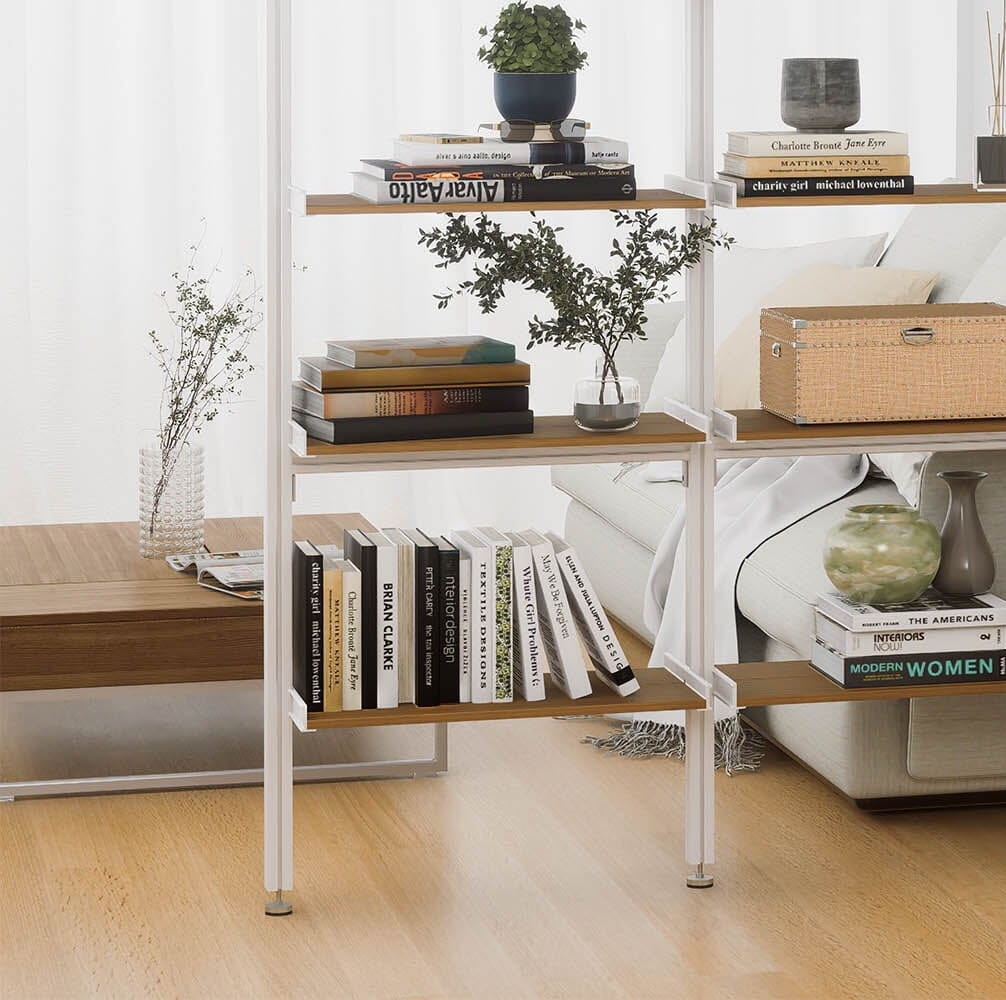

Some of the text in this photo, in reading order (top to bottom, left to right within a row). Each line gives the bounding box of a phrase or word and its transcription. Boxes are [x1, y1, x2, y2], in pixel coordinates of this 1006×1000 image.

[772, 142, 810, 151] Charlotte
[844, 138, 866, 149] Jane
[867, 138, 886, 148] Eyre
[752, 178, 905, 192] charity girl michael lowenthal
[425, 567, 433, 616] PETER CAREY
[540, 554, 570, 639] May We Be Forgiven
[348, 591, 356, 626] Charlotte
[573, 574, 584, 588] AND
[581, 589, 592, 606] JULIA
[589, 605, 605, 631] LUPTON
[525, 604, 535, 626] Girl
[909, 617, 928, 625] THE
[932, 614, 994, 624] AMERICANS
[312, 562, 320, 704] charity girl michael lowenthal
[383, 583, 393, 670] BRIAN CLARKE
[873, 632, 924, 643] INTERIORS
[873, 642, 903, 652] NOW!
[528, 628, 538, 676] Problems
[348, 654, 358, 672] Jane
[850, 662, 903, 674] MODERN
[906, 658, 993, 678] WOMEN
[348, 674, 358, 691] Eyre
